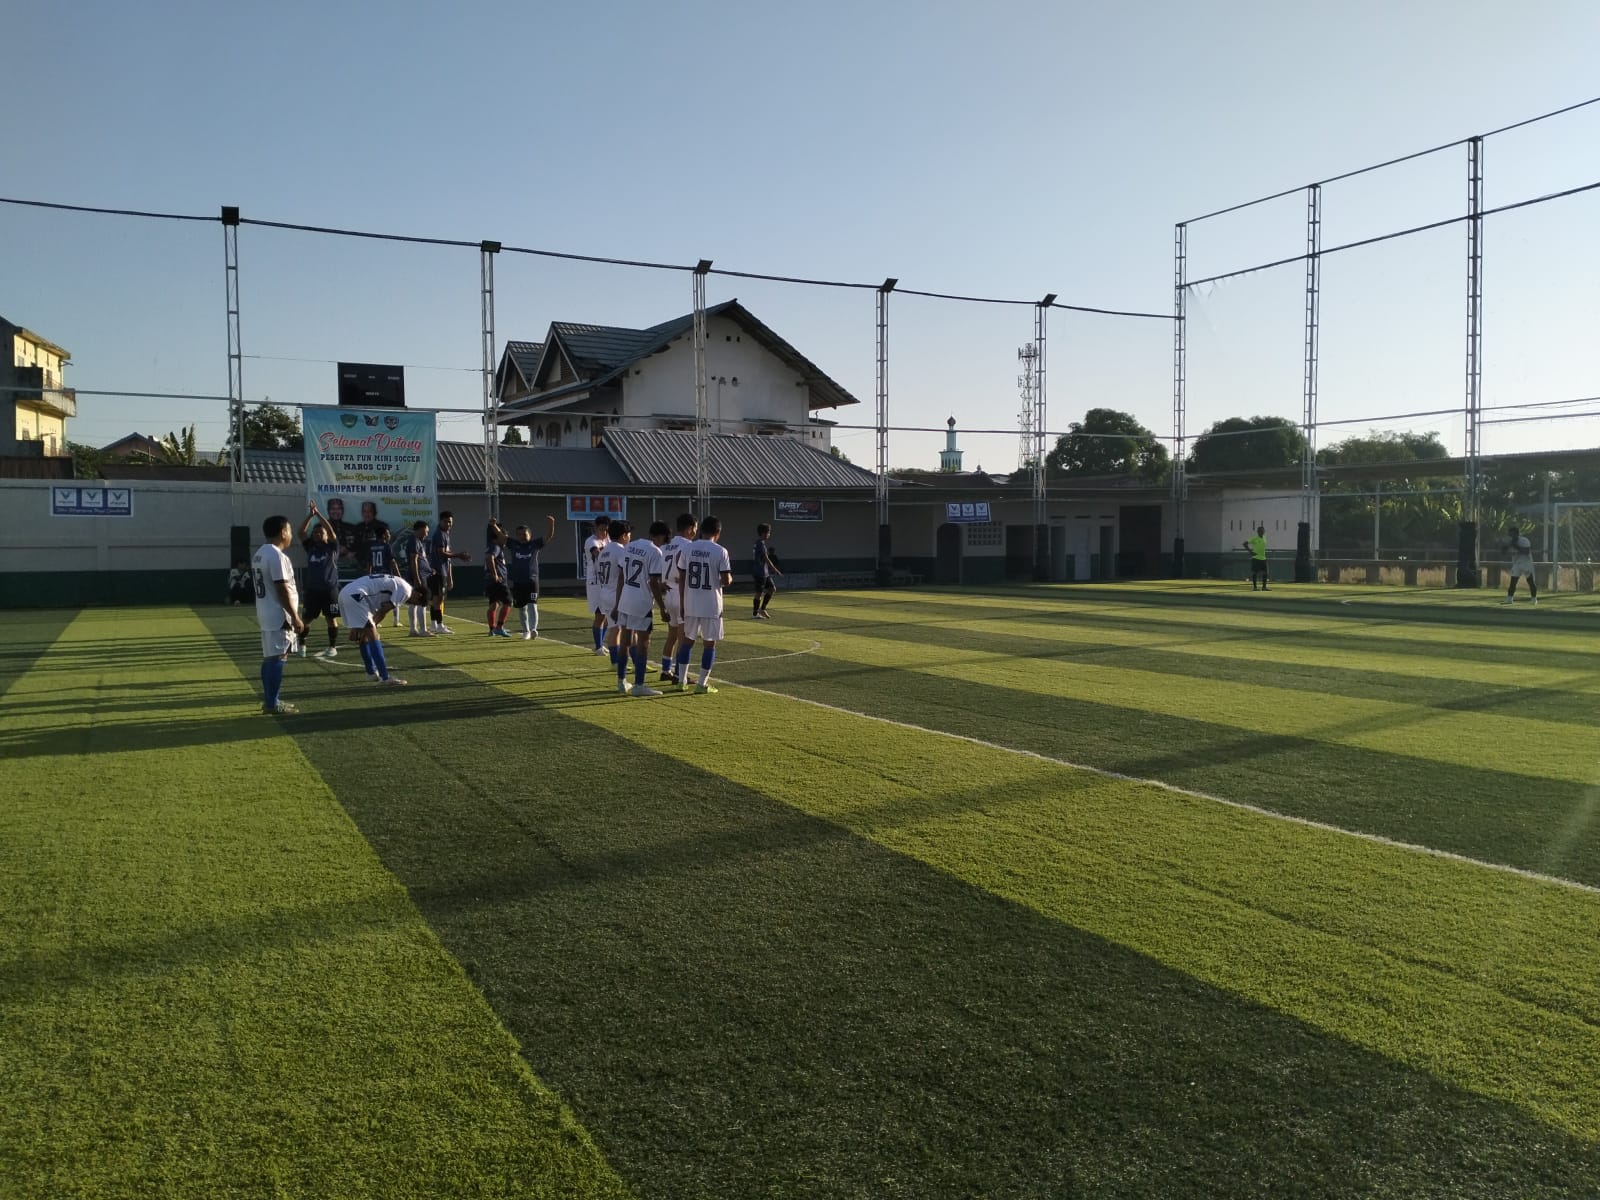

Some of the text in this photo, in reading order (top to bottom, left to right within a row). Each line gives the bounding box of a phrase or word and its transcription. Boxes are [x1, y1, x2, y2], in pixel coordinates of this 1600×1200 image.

[318, 432, 422, 452] Selamat Datang
[320, 453, 421, 463] PESERTA FUN MINI SOCCER
[344, 463, 401, 471] MAROS CUP 1
[318, 484, 426, 493] KABUPATEN MAROS KE-67
[372, 551, 383, 567] 10
[664, 554, 674, 580] 7
[624, 556, 644, 588] 12
[688, 562, 713, 590] 81
